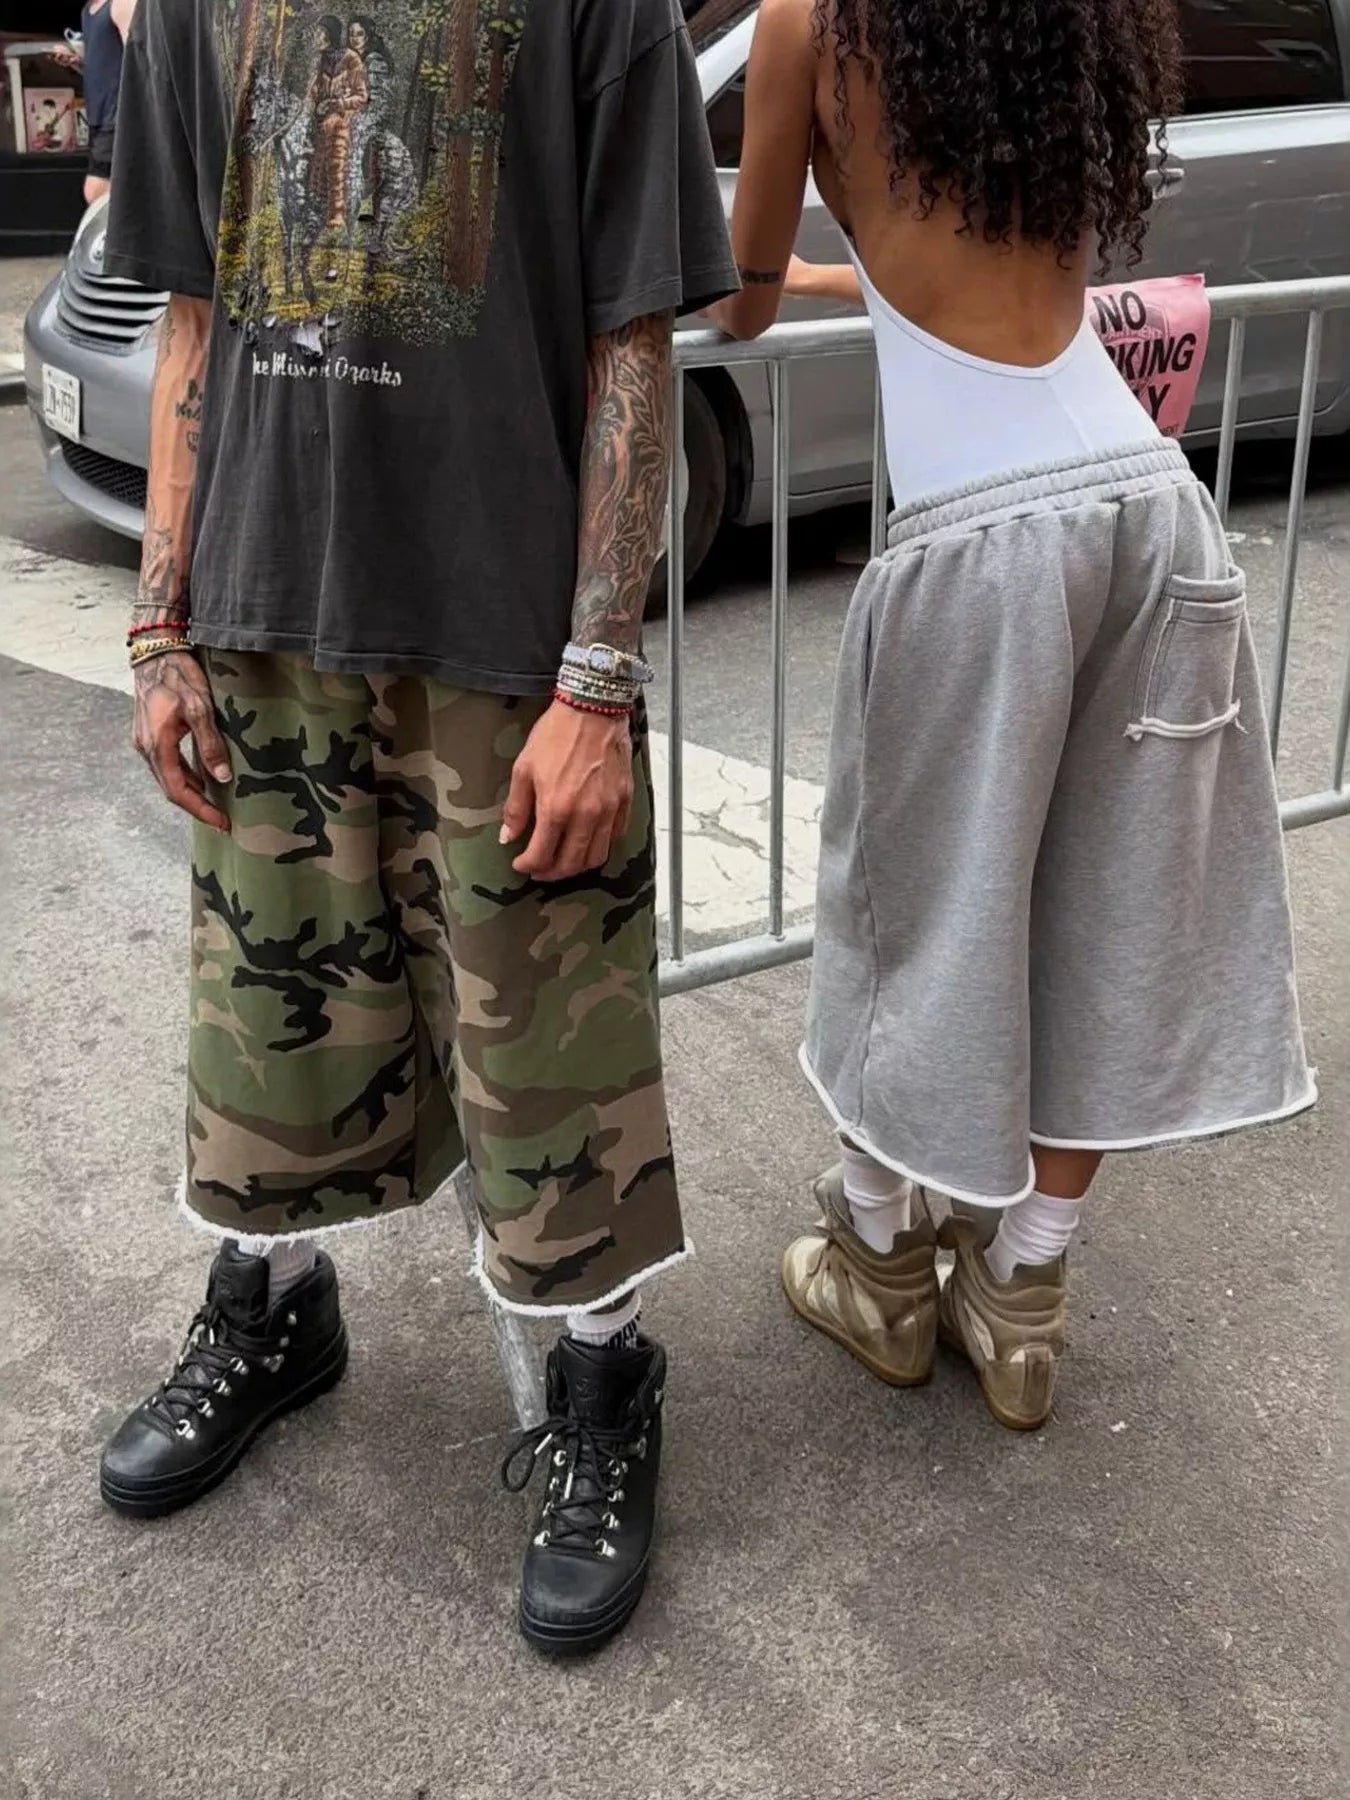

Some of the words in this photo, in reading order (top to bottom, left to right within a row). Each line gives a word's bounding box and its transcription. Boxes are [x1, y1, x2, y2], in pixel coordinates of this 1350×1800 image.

[1092, 291, 1147, 334] NO
[335, 356, 402, 386] Ozarks
[1104, 333, 1197, 381] KING
